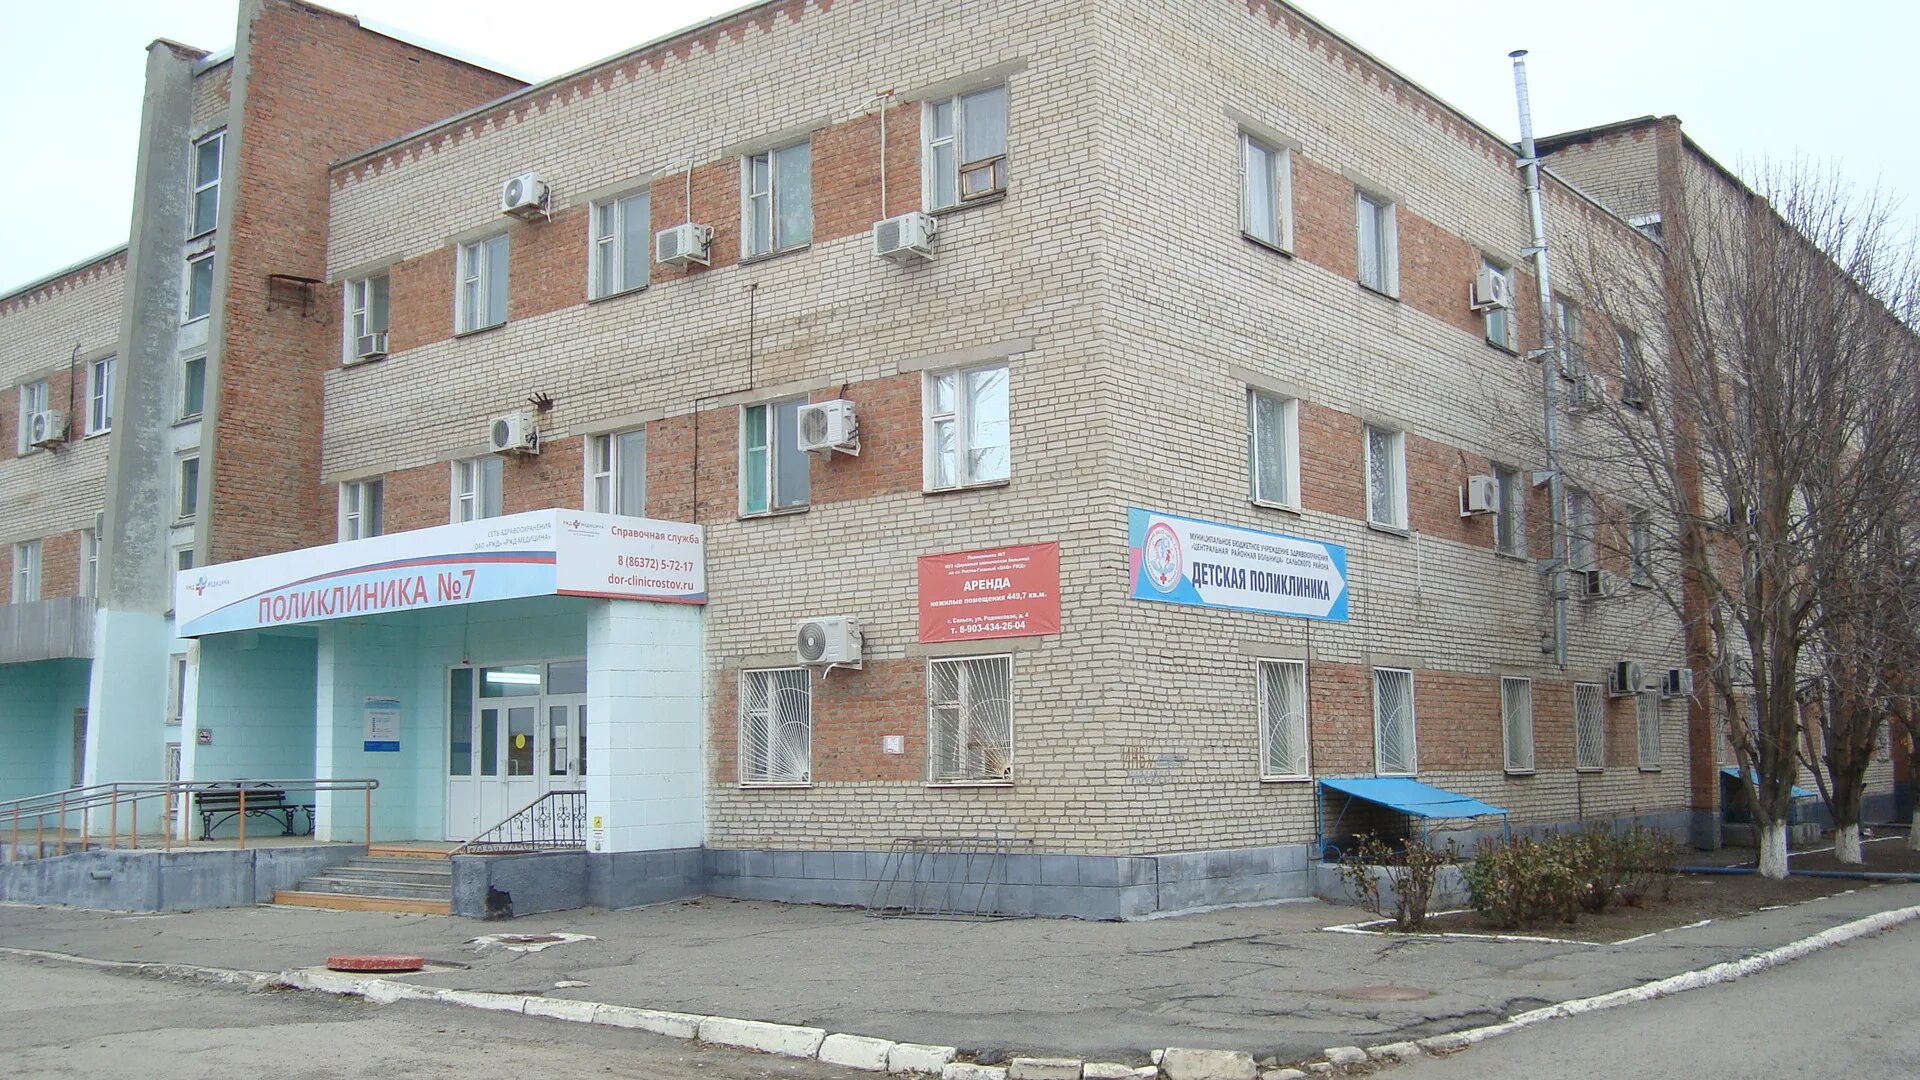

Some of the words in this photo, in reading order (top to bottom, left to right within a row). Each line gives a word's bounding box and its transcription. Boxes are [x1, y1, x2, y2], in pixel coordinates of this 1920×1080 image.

[612, 526, 665, 540] Справочная
[668, 532, 700, 544] служба
[1190, 532, 1231, 546] МУНИЦИПАЛЬНОЕ
[1232, 540, 1260, 551] БЮДЖЕТНОЕ
[1260, 544, 1289, 556] УЧРЕЖДЕНИЕ
[618, 555, 624, 566] 8
[626, 556, 658, 570] (86372)
[661, 559, 694, 572] 5-72-17
[1231, 550, 1256, 560] РАЙОННАЯ
[1286, 558, 1311, 568] САЛЬСКОГО
[1312, 562, 1328, 570] РАЙОНА
[608, 574, 694, 590] dor-clinicrostov.ru
[964, 577, 1010, 591] АРЕНДА
[1192, 562, 1246, 590] ДЕТСКАЯ
[1250, 570, 1330, 600] ПОЛИКЛИНИКА
[258, 576, 428, 623] ПОЛИКЛИНИКА
[438, 569, 476, 601] №7
[930, 599, 962, 607] нежилые
[964, 595, 1006, 604] помещения
[1007, 592, 1026, 600] 449,7
[960, 621, 1026, 634] 8-903-434-26-04
